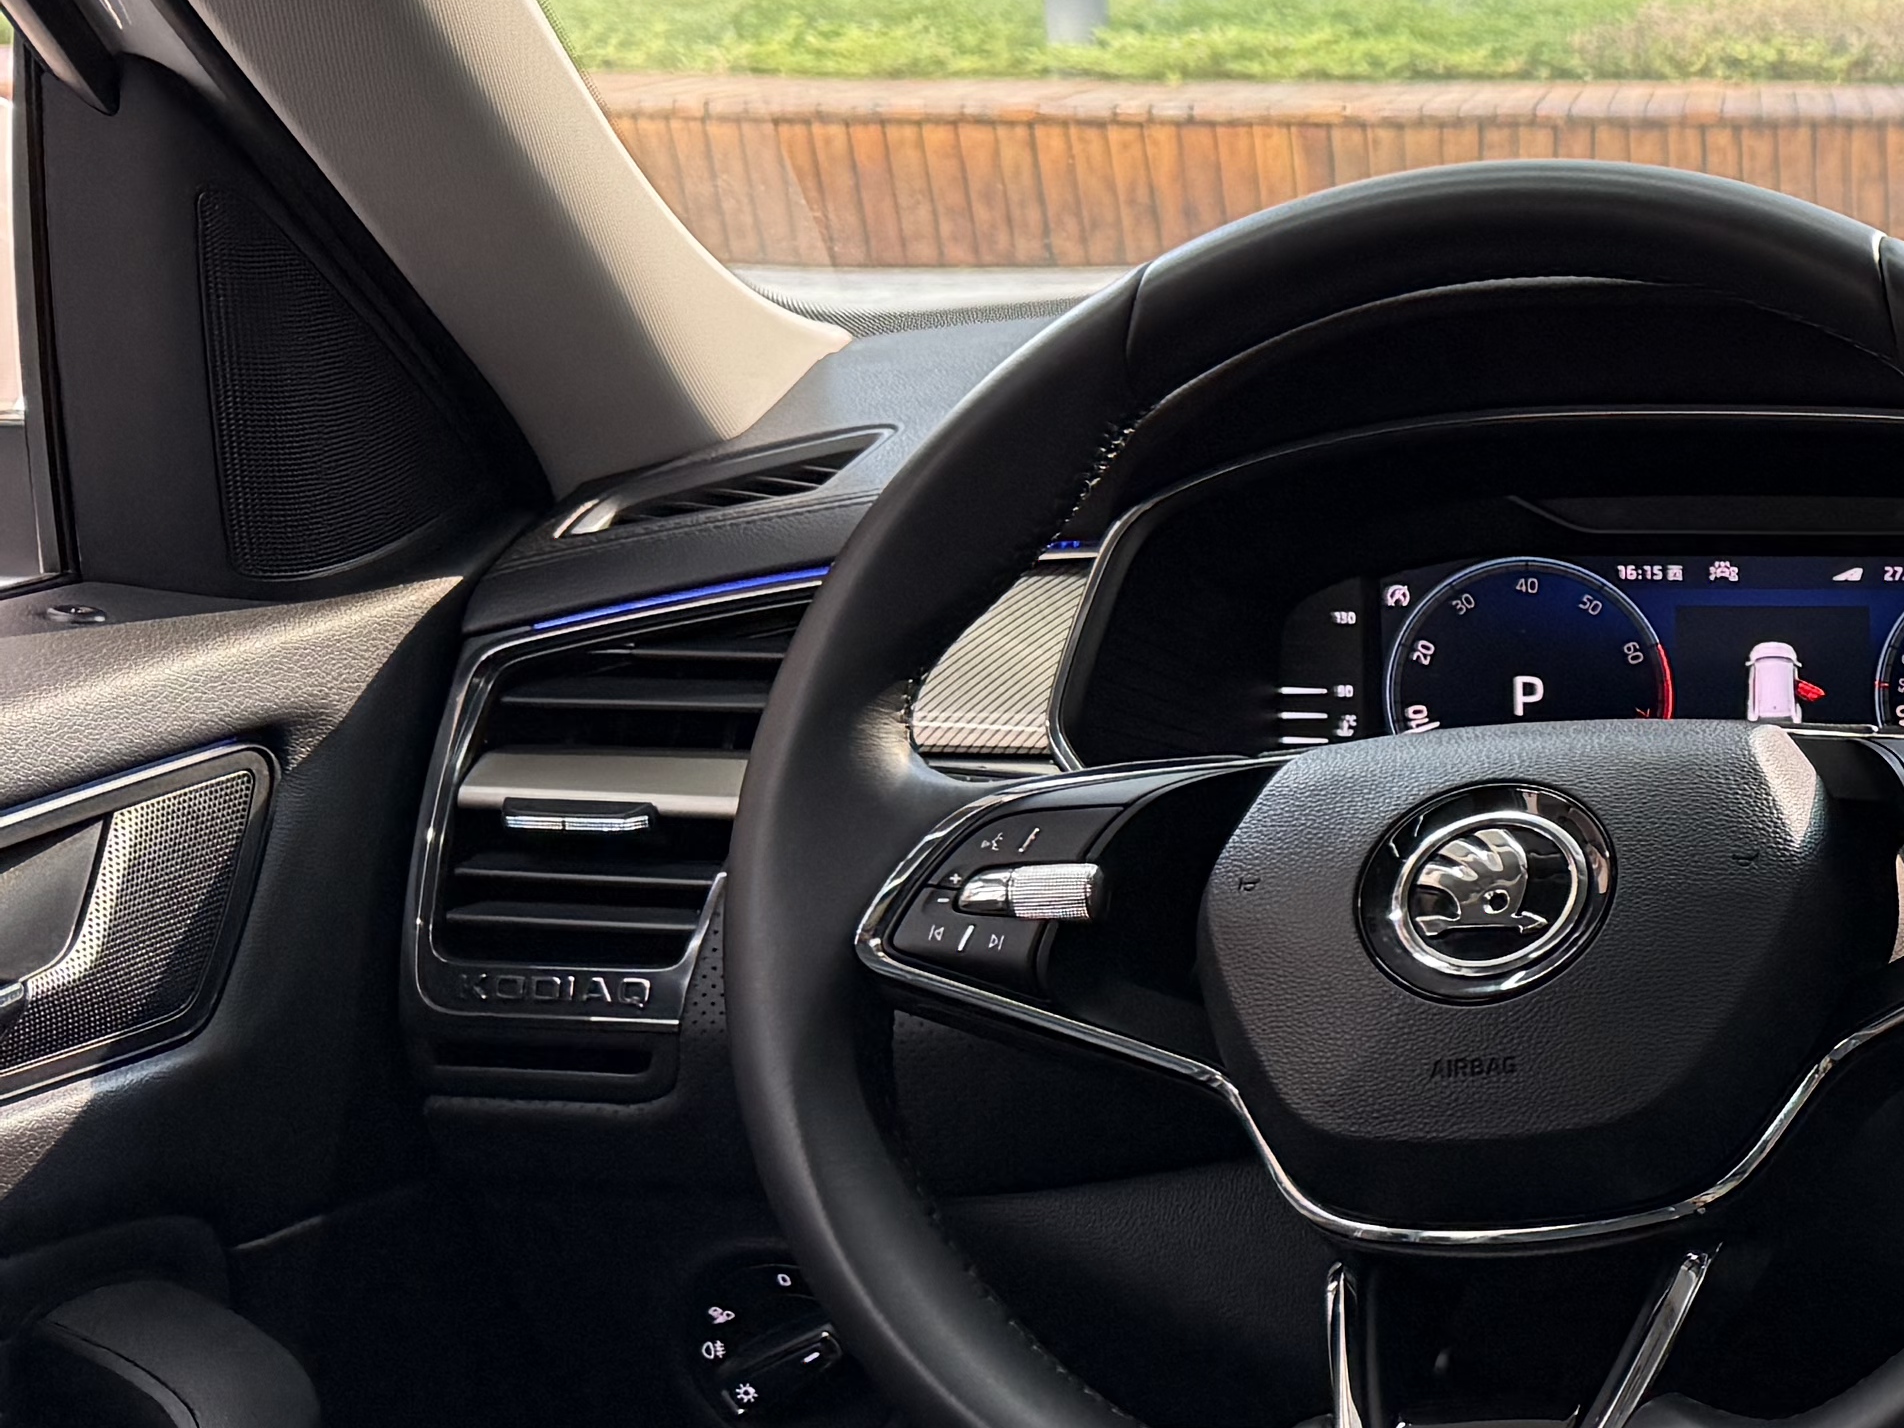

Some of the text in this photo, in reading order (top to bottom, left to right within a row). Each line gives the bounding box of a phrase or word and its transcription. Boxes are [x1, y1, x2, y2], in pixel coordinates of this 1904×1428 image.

[1617, 565, 1663, 580] 16:15
[1516, 578, 1538, 593] 40
[1451, 593, 1476, 616] 30
[1579, 595, 1602, 615] 50
[1413, 640, 1434, 665] 20
[1624, 642, 1643, 664] 60
[1514, 676, 1543, 716] P
[460, 973, 650, 1008] KODIAQ
[1430, 1055, 1516, 1080] AIRBAG
